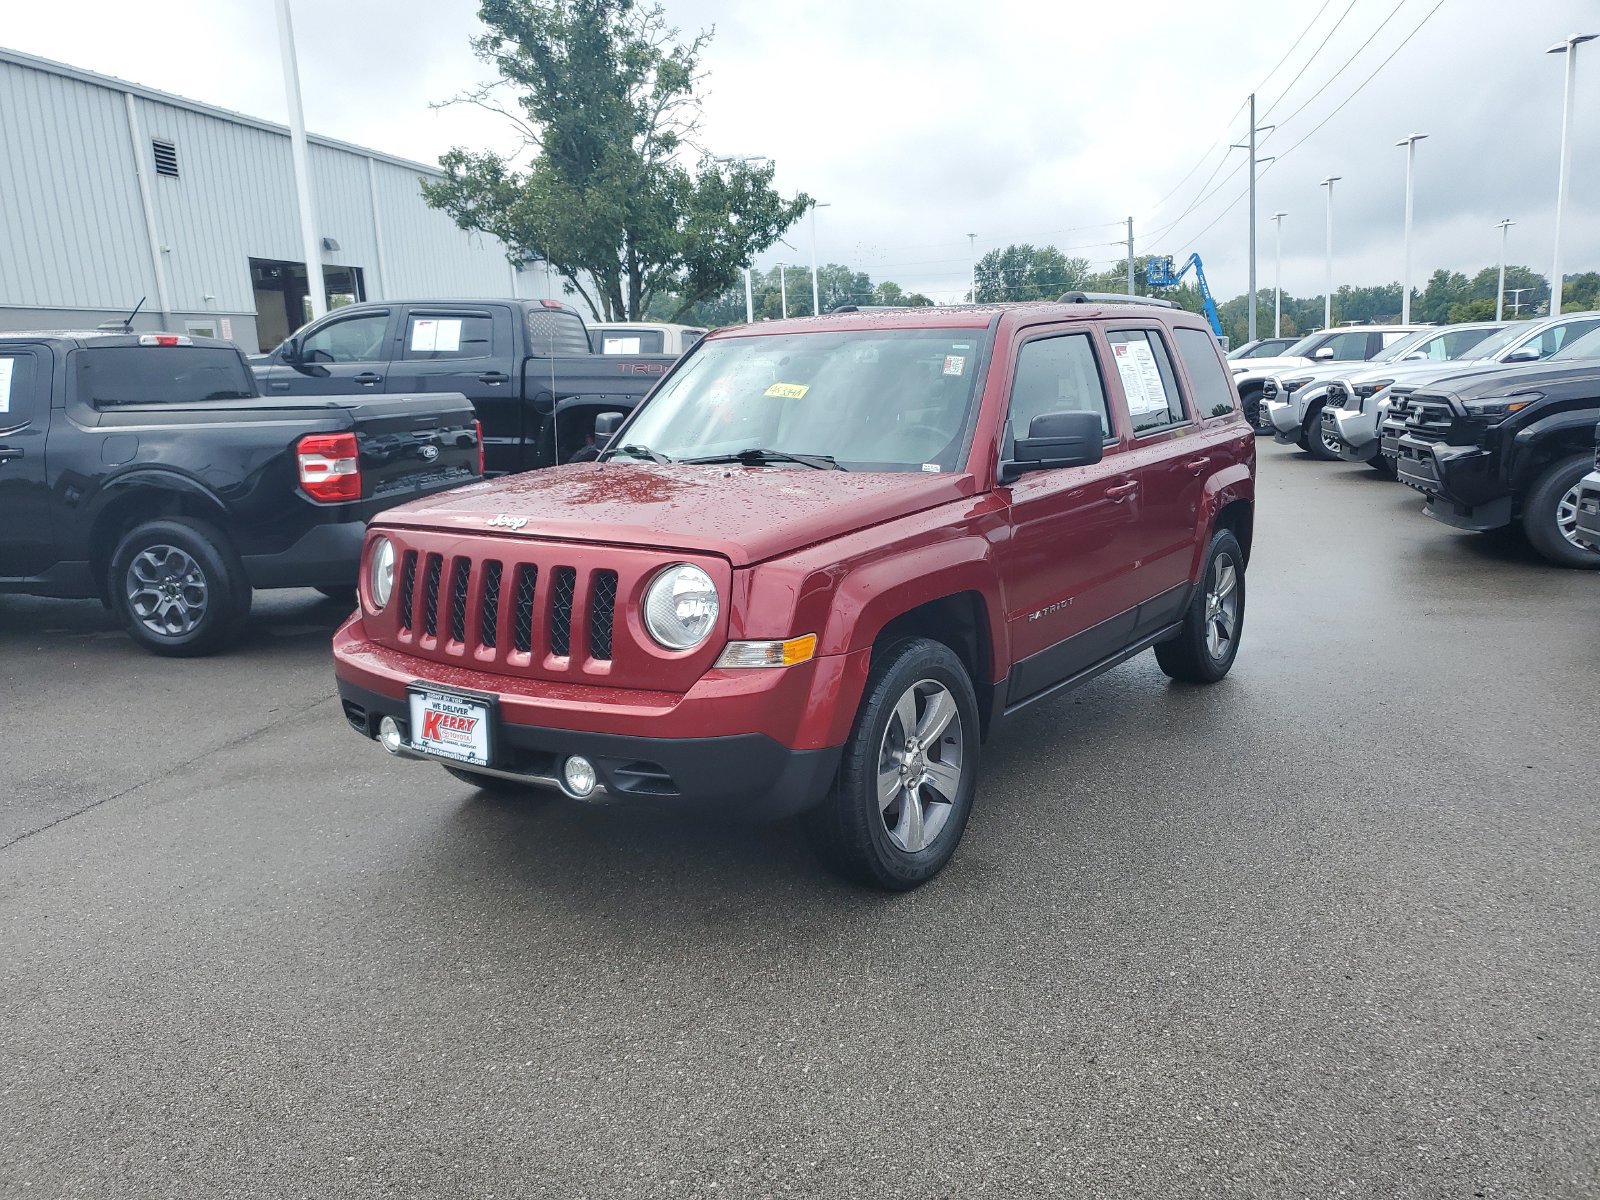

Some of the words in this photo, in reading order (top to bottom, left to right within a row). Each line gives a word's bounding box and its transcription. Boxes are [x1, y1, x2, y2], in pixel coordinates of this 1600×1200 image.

[617, 363, 663, 374] TRD
[487, 513, 528, 531] Jeep
[1028, 596, 1076, 622] PATRIOT
[432, 702, 442, 710] WE
[443, 704, 469, 715] DELIVER
[422, 709, 477, 741] KERRY
[450, 732, 471, 742] TOYOTA
